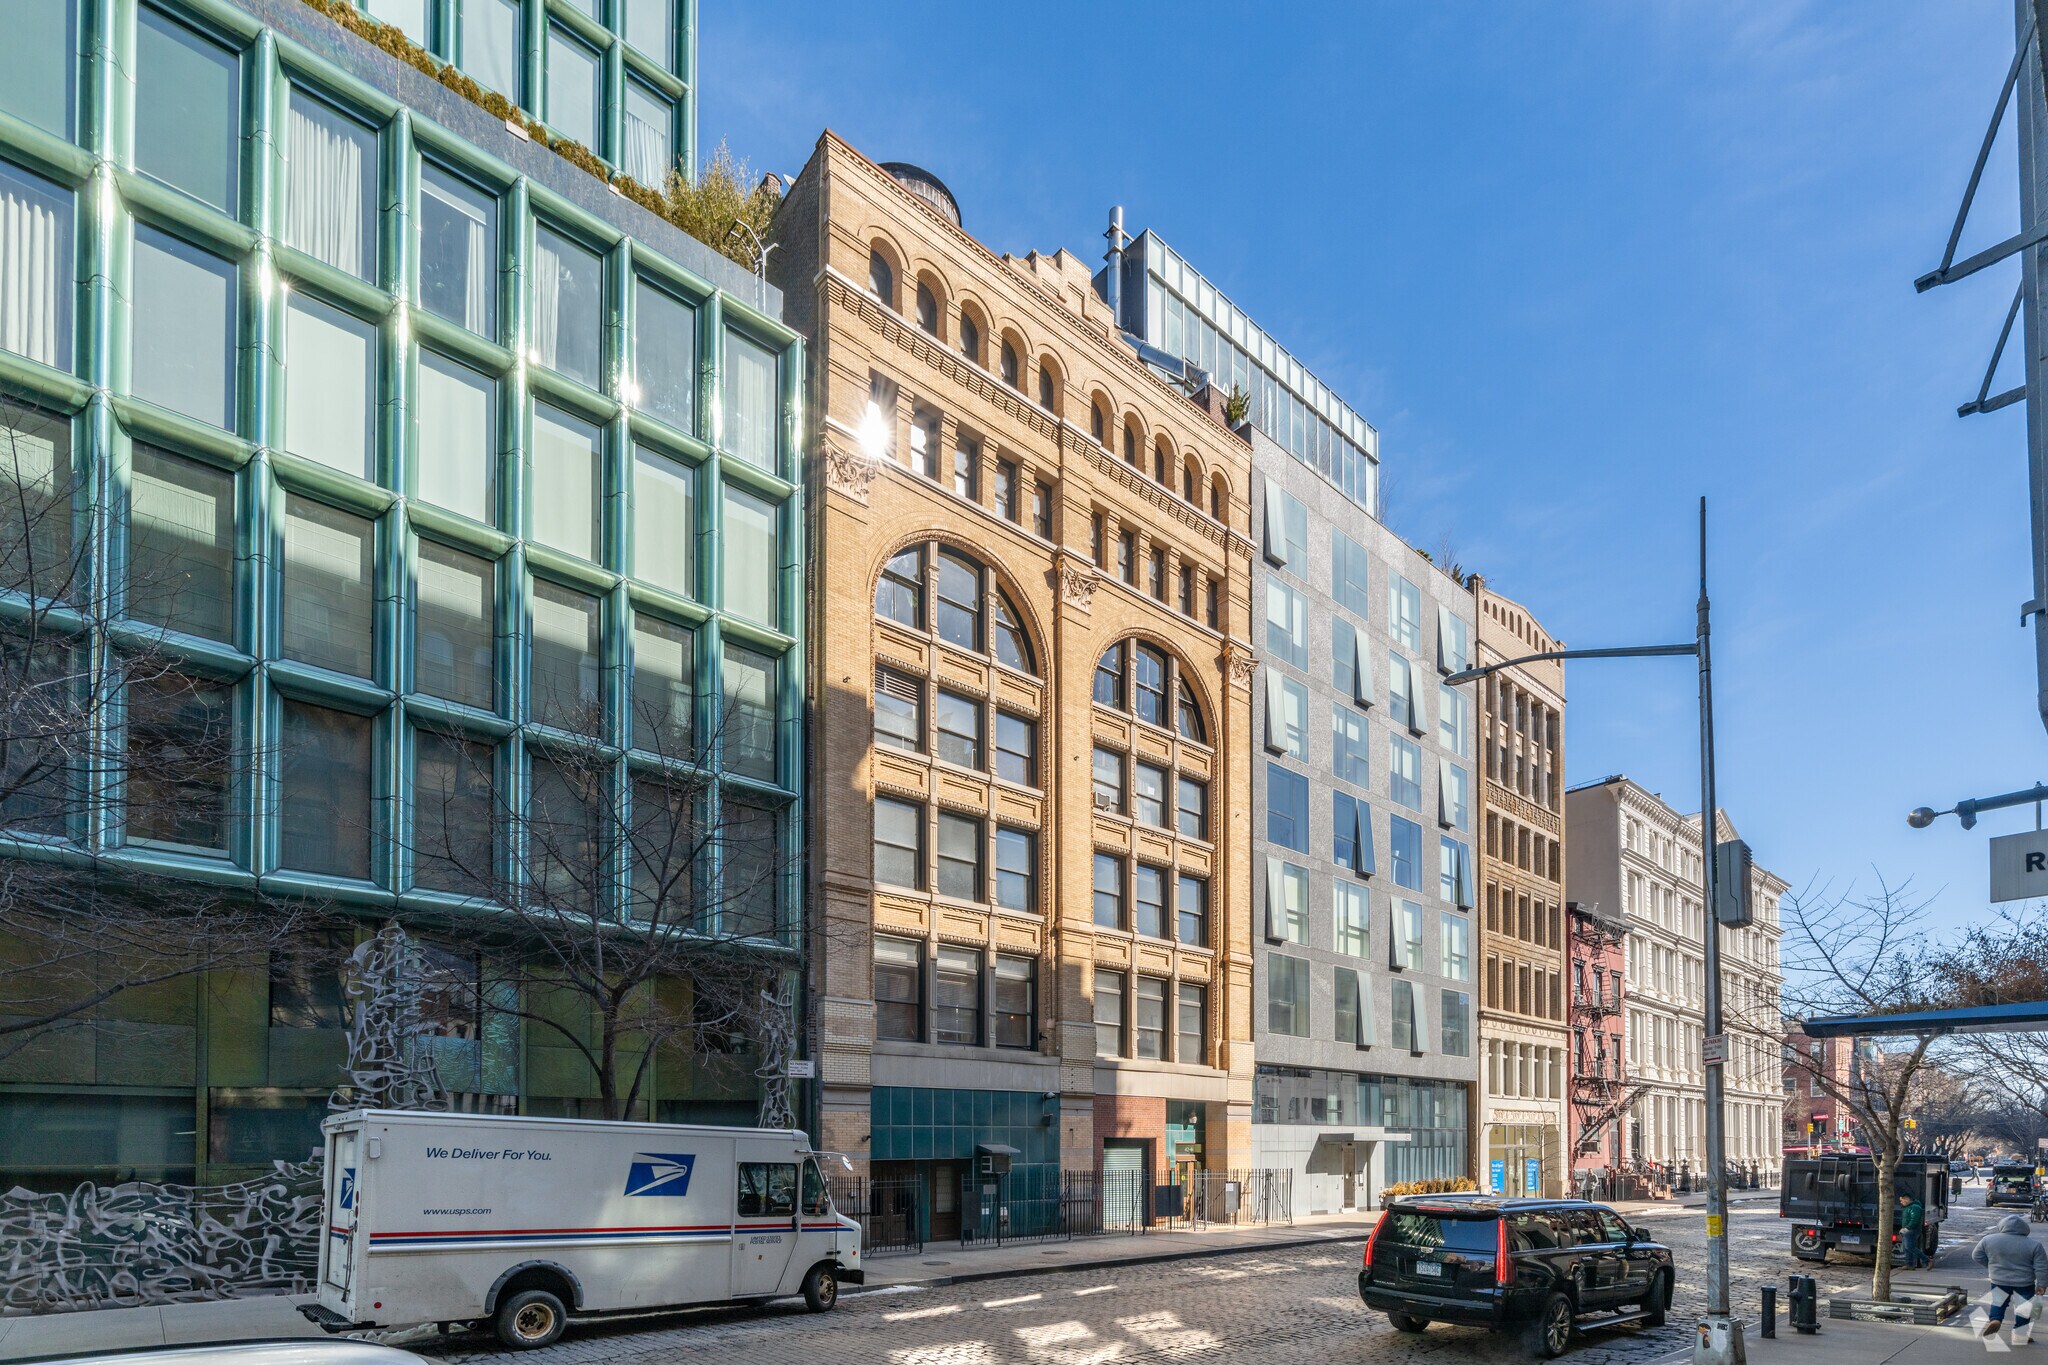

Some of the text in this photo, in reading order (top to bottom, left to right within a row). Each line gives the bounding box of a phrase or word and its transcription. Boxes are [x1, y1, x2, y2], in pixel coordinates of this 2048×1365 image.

[2026, 851, 2048, 872] R
[426, 1147, 552, 1161] We Deliver For You.
[423, 1208, 492, 1216] www.usps.com
